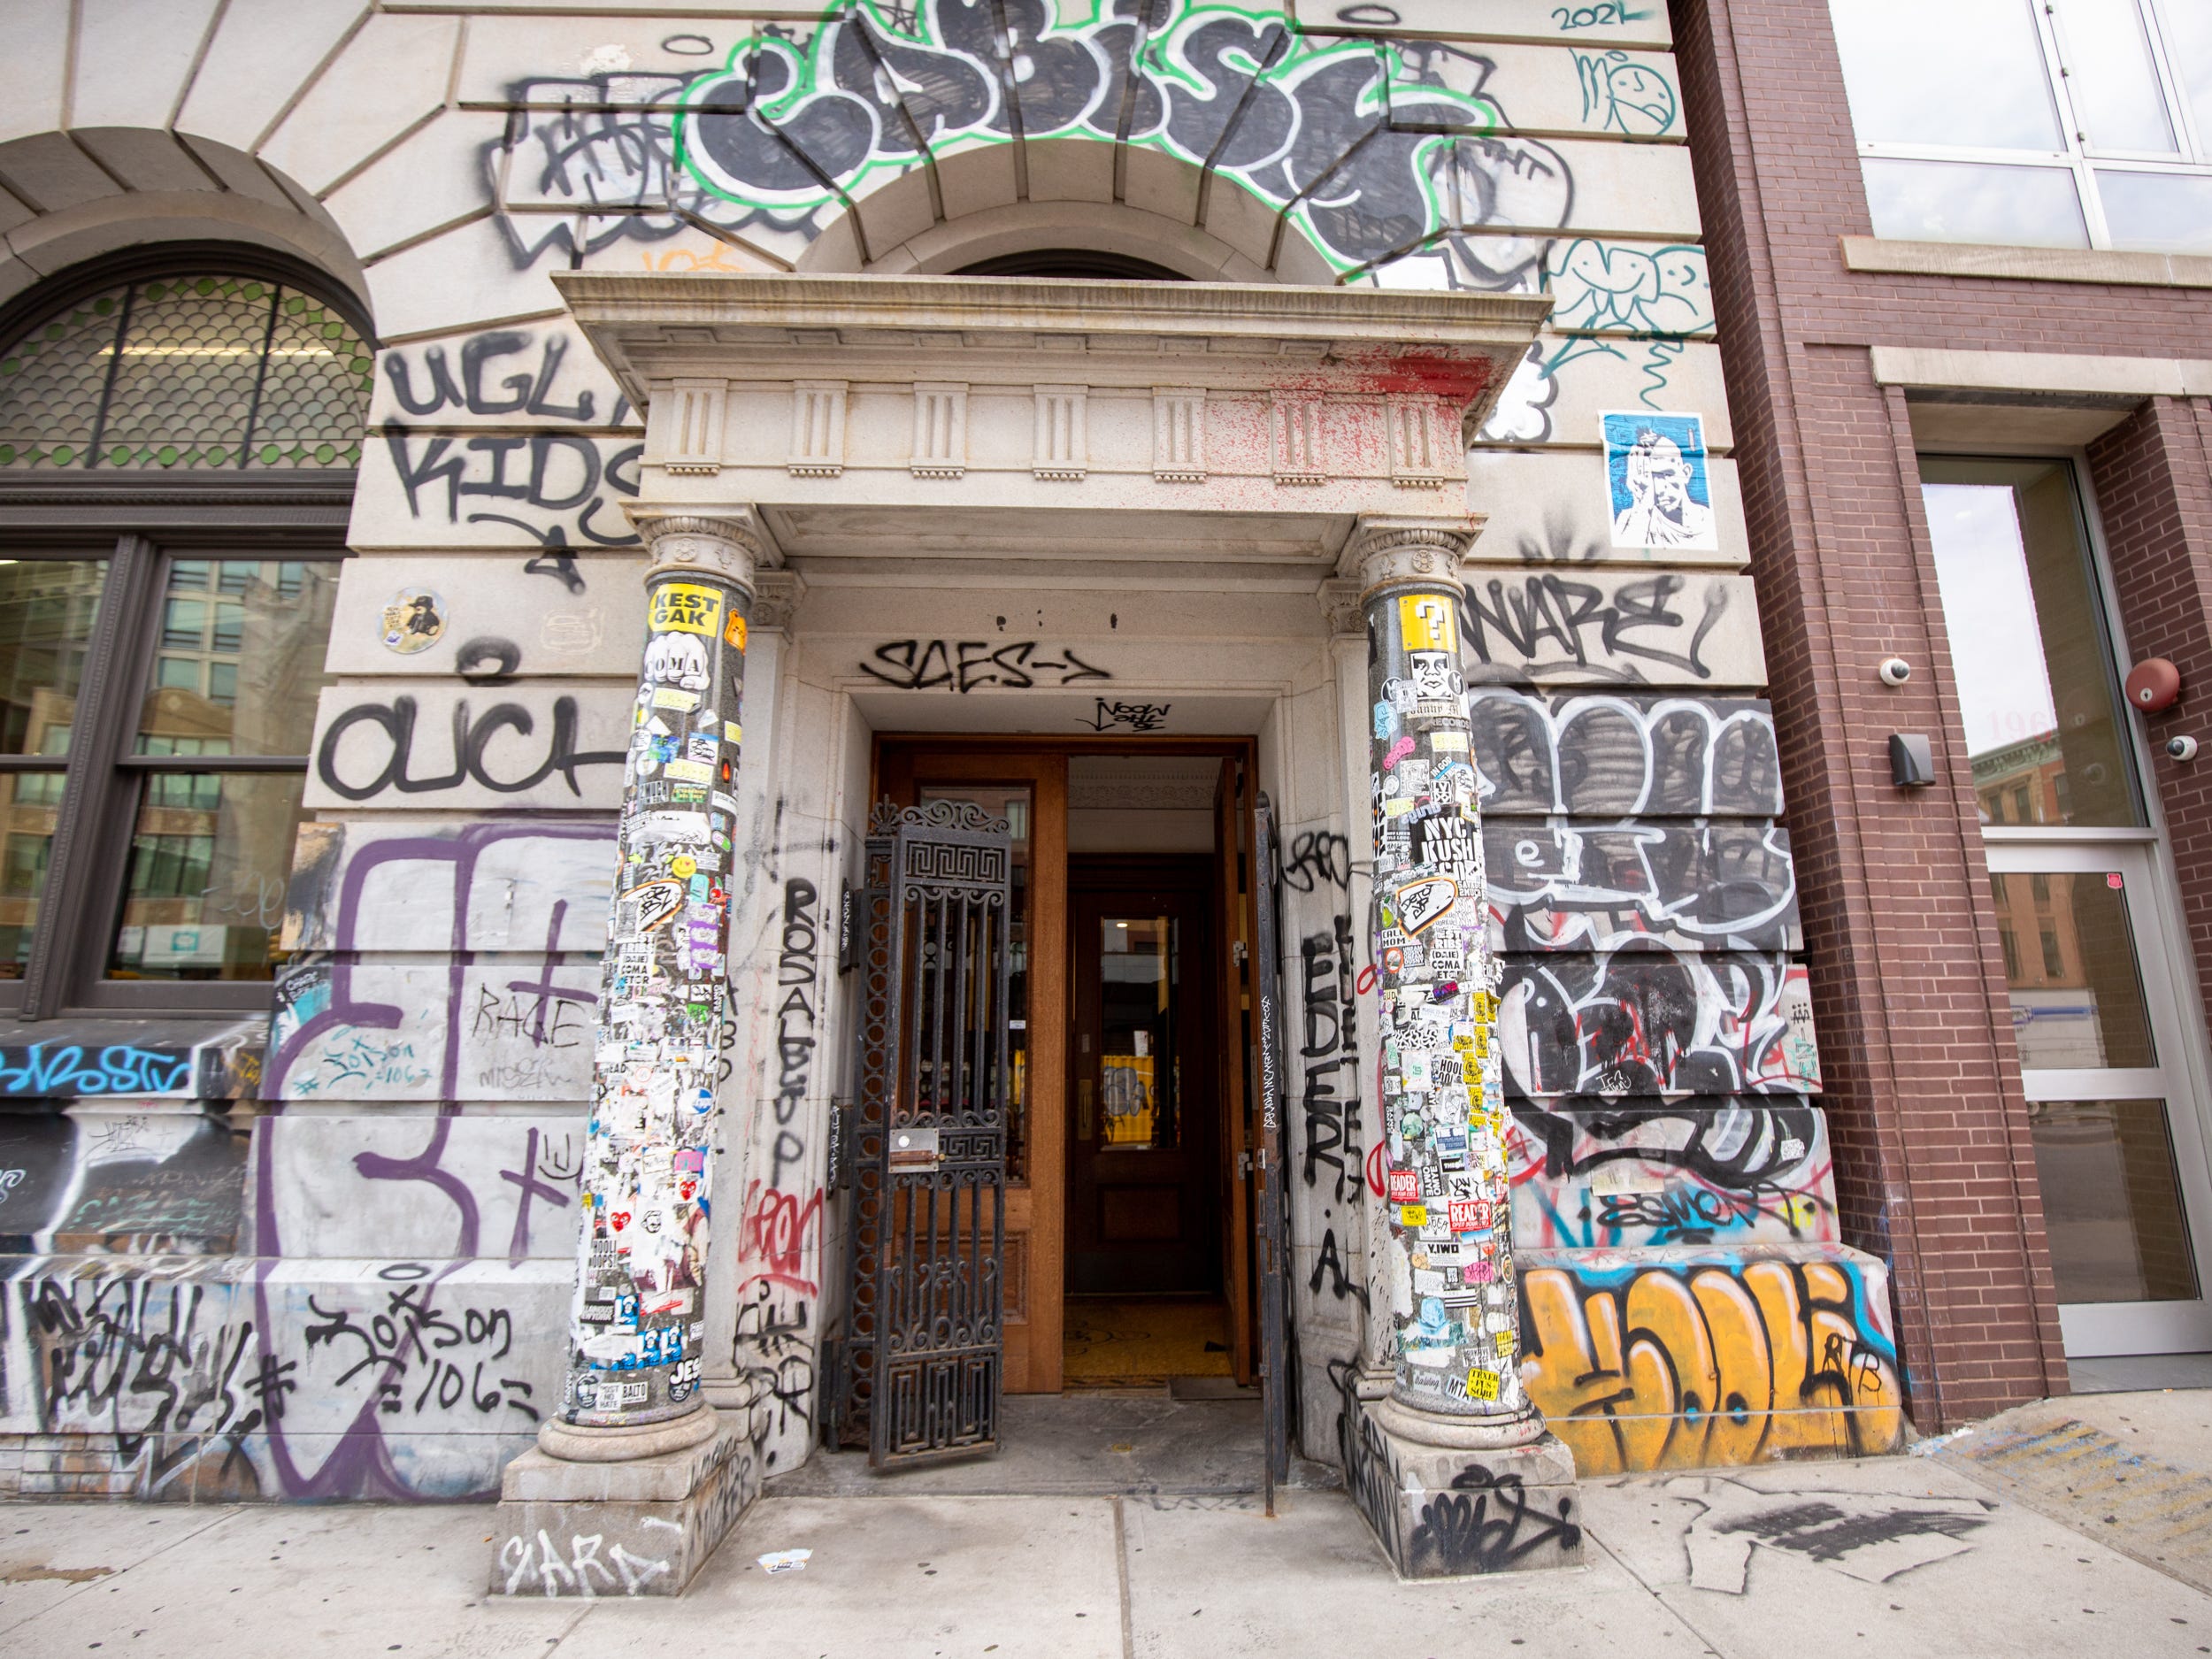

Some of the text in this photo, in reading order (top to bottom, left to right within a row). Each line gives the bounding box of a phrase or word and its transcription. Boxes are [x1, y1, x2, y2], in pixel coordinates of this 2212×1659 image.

[1423, 816, 1467, 841] NYC
[1421, 837, 1474, 866] KUSH
[1383, 937, 1406, 948] MOM
[1449, 1203, 1489, 1223] READER
